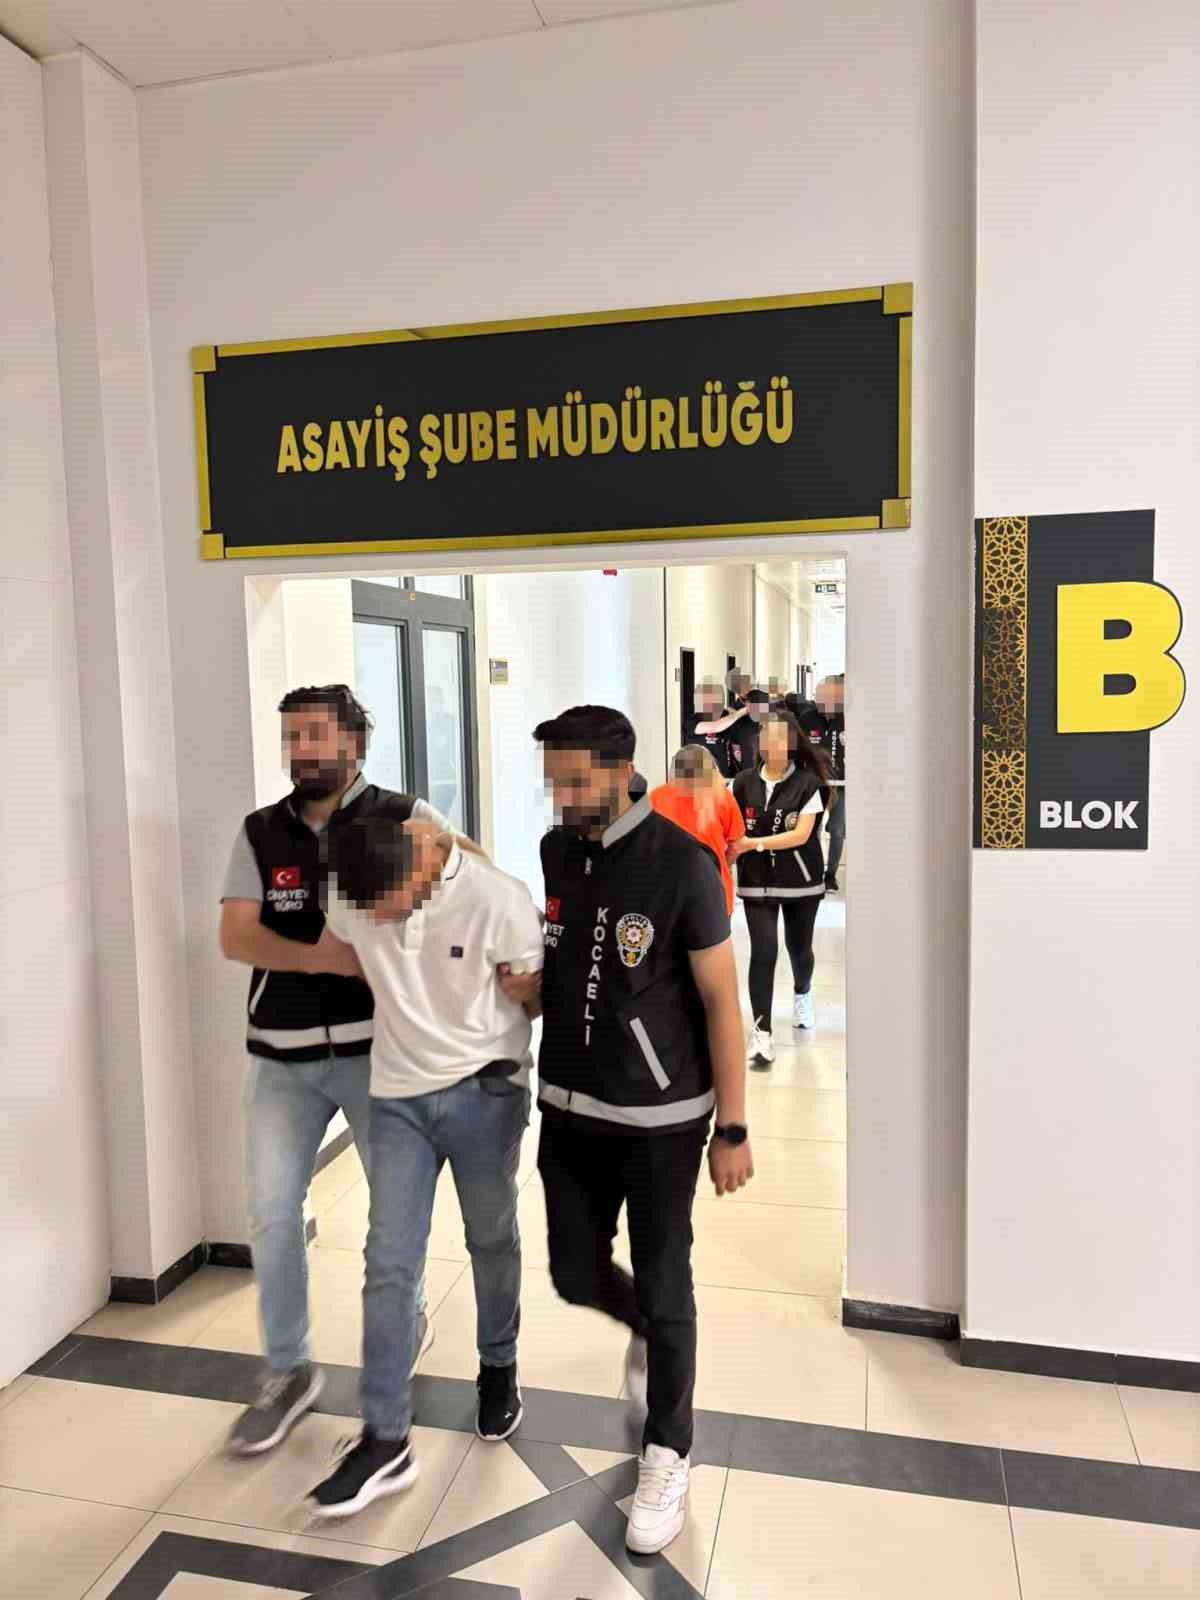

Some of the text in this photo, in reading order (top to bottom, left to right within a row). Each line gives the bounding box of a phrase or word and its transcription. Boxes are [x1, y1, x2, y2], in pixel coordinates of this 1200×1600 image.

[276, 376, 793, 481] ASAYİŞ ŞUBE MÜDÜRLÜĞÜ
[1057, 581, 1186, 734] B
[1039, 800, 1140, 830] BLOK
